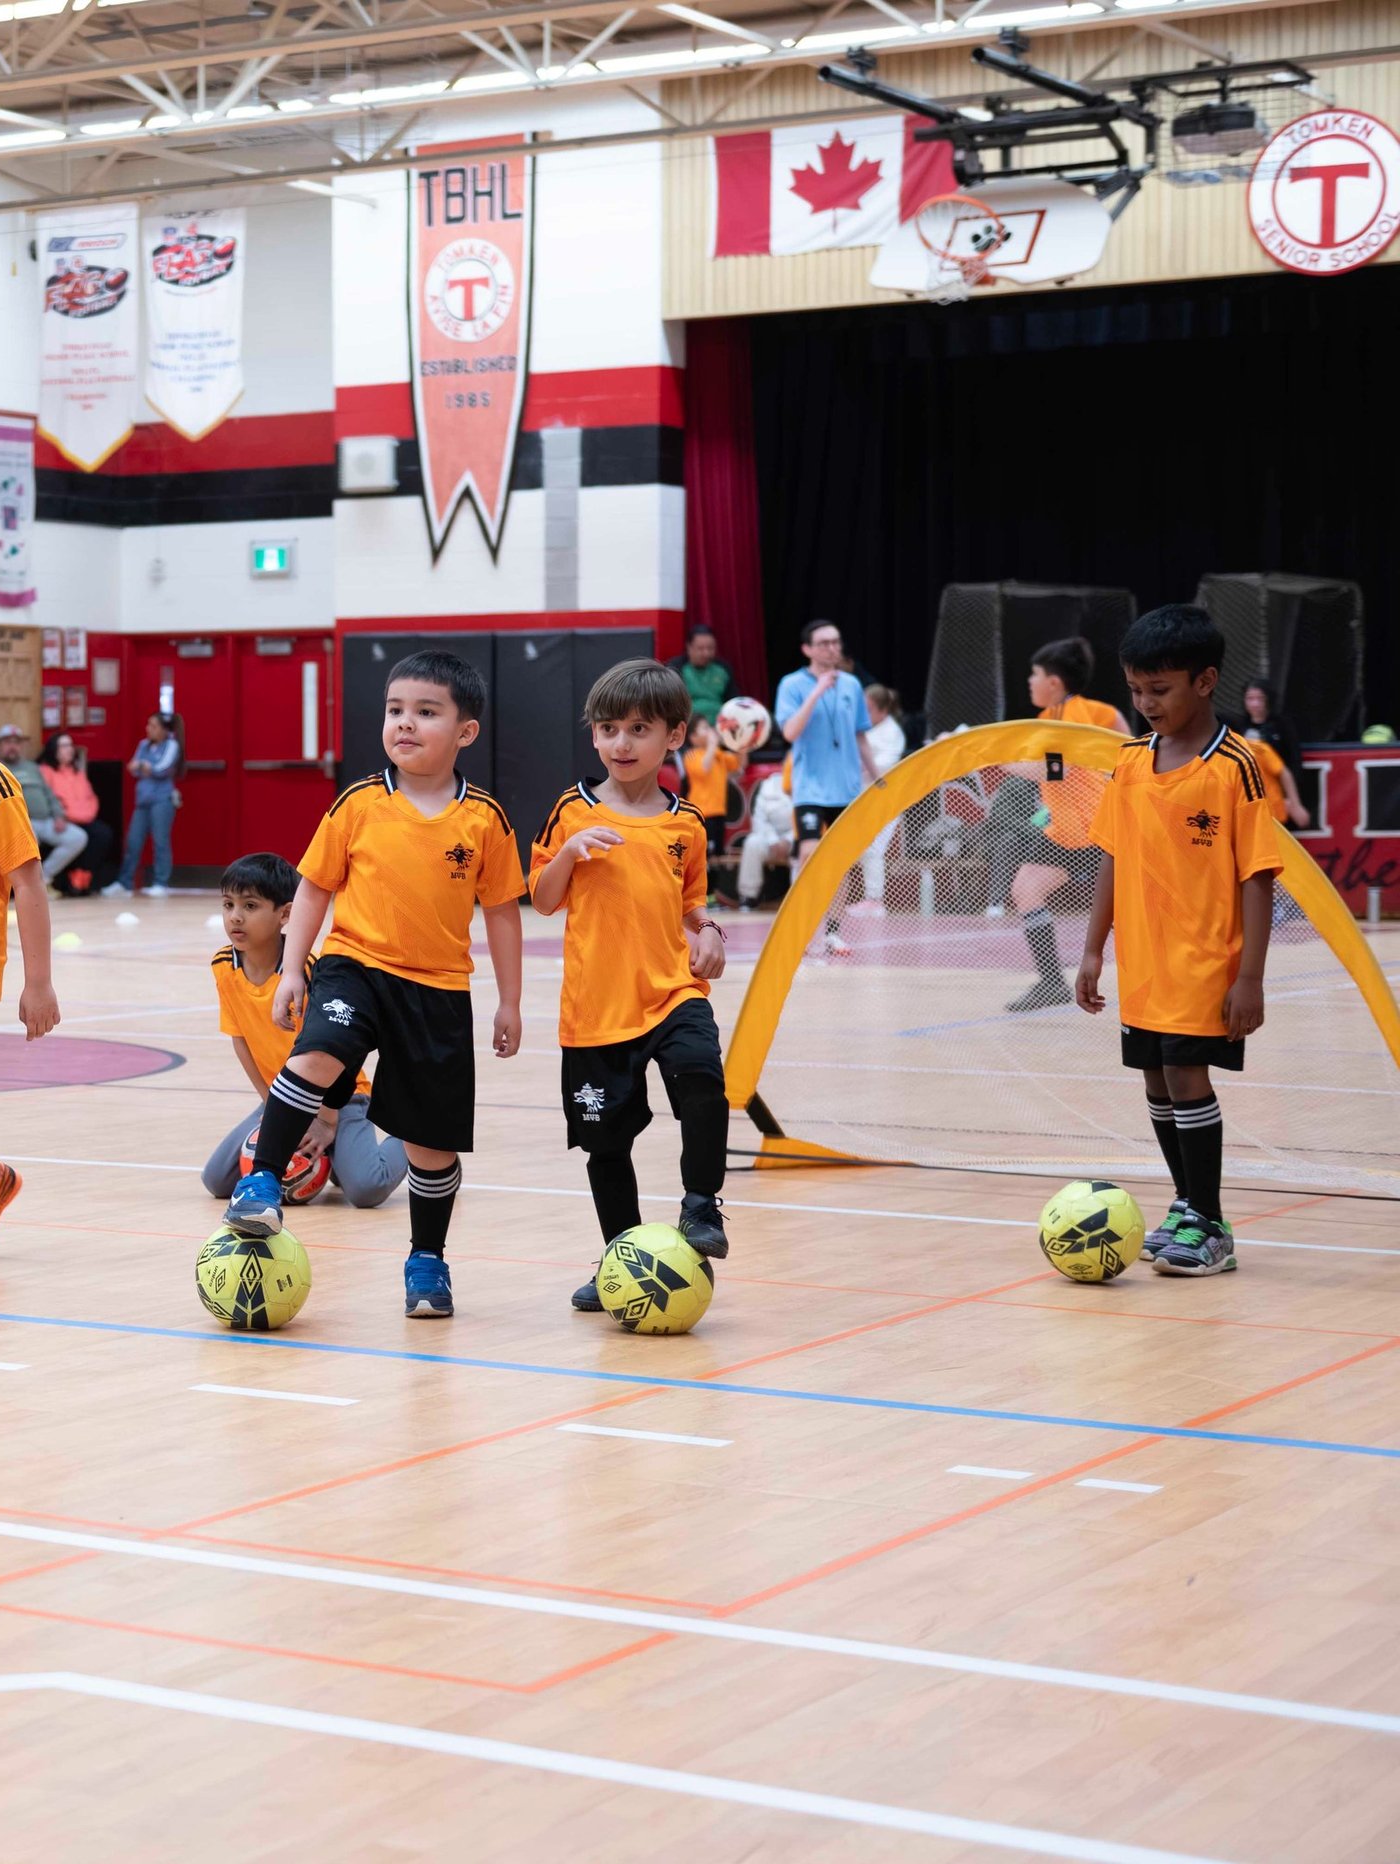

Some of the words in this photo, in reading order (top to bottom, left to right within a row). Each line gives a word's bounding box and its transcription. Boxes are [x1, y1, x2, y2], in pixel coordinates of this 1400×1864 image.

[1285, 115, 1376, 143] TOMKEN
[419, 163, 523, 227] TBHL
[1289, 163, 1370, 246] T
[437, 245, 501, 271] TOMKEN
[1257, 218, 1321, 268] SENIOR
[1330, 211, 1400, 268] SCHOOL
[448, 277, 489, 320] T
[421, 356, 518, 377] ESTABLISHED
